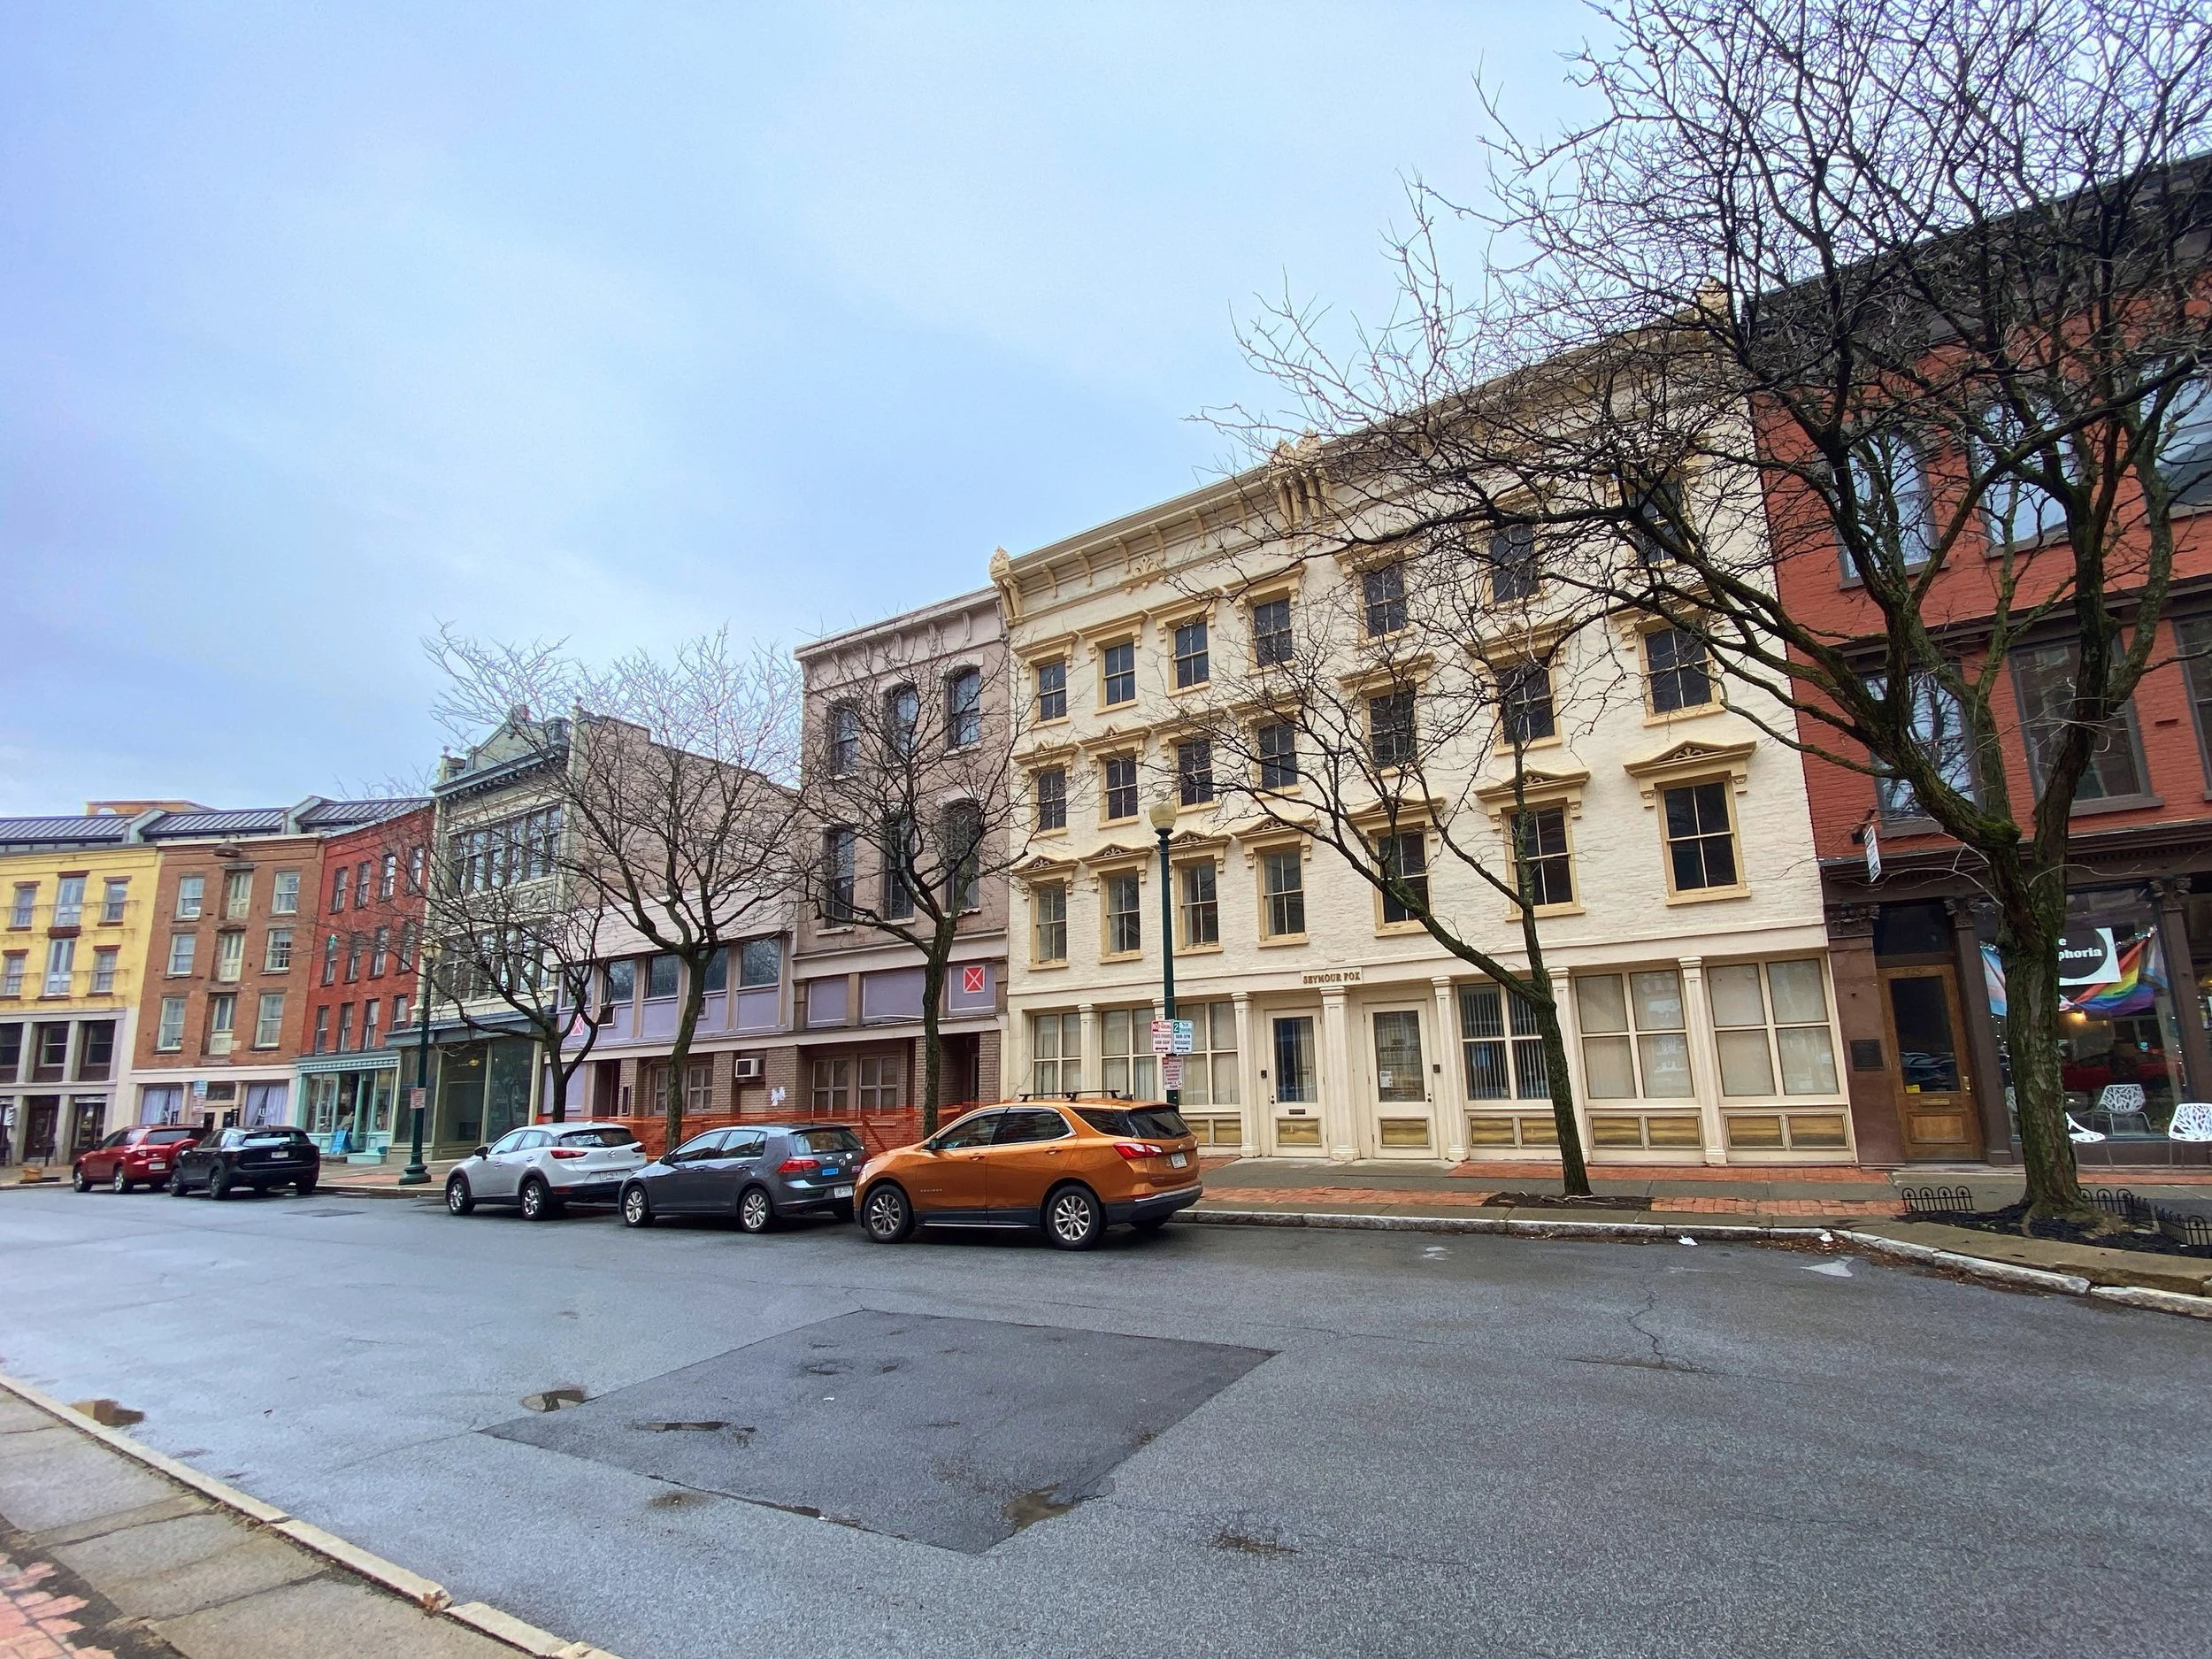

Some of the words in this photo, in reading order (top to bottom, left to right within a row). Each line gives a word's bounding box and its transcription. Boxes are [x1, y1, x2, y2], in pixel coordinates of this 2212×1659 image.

[1303, 973, 1342, 984] SEYMOUR
[1343, 972, 1361, 981] FOX
[1173, 1023, 1179, 1032] 2
